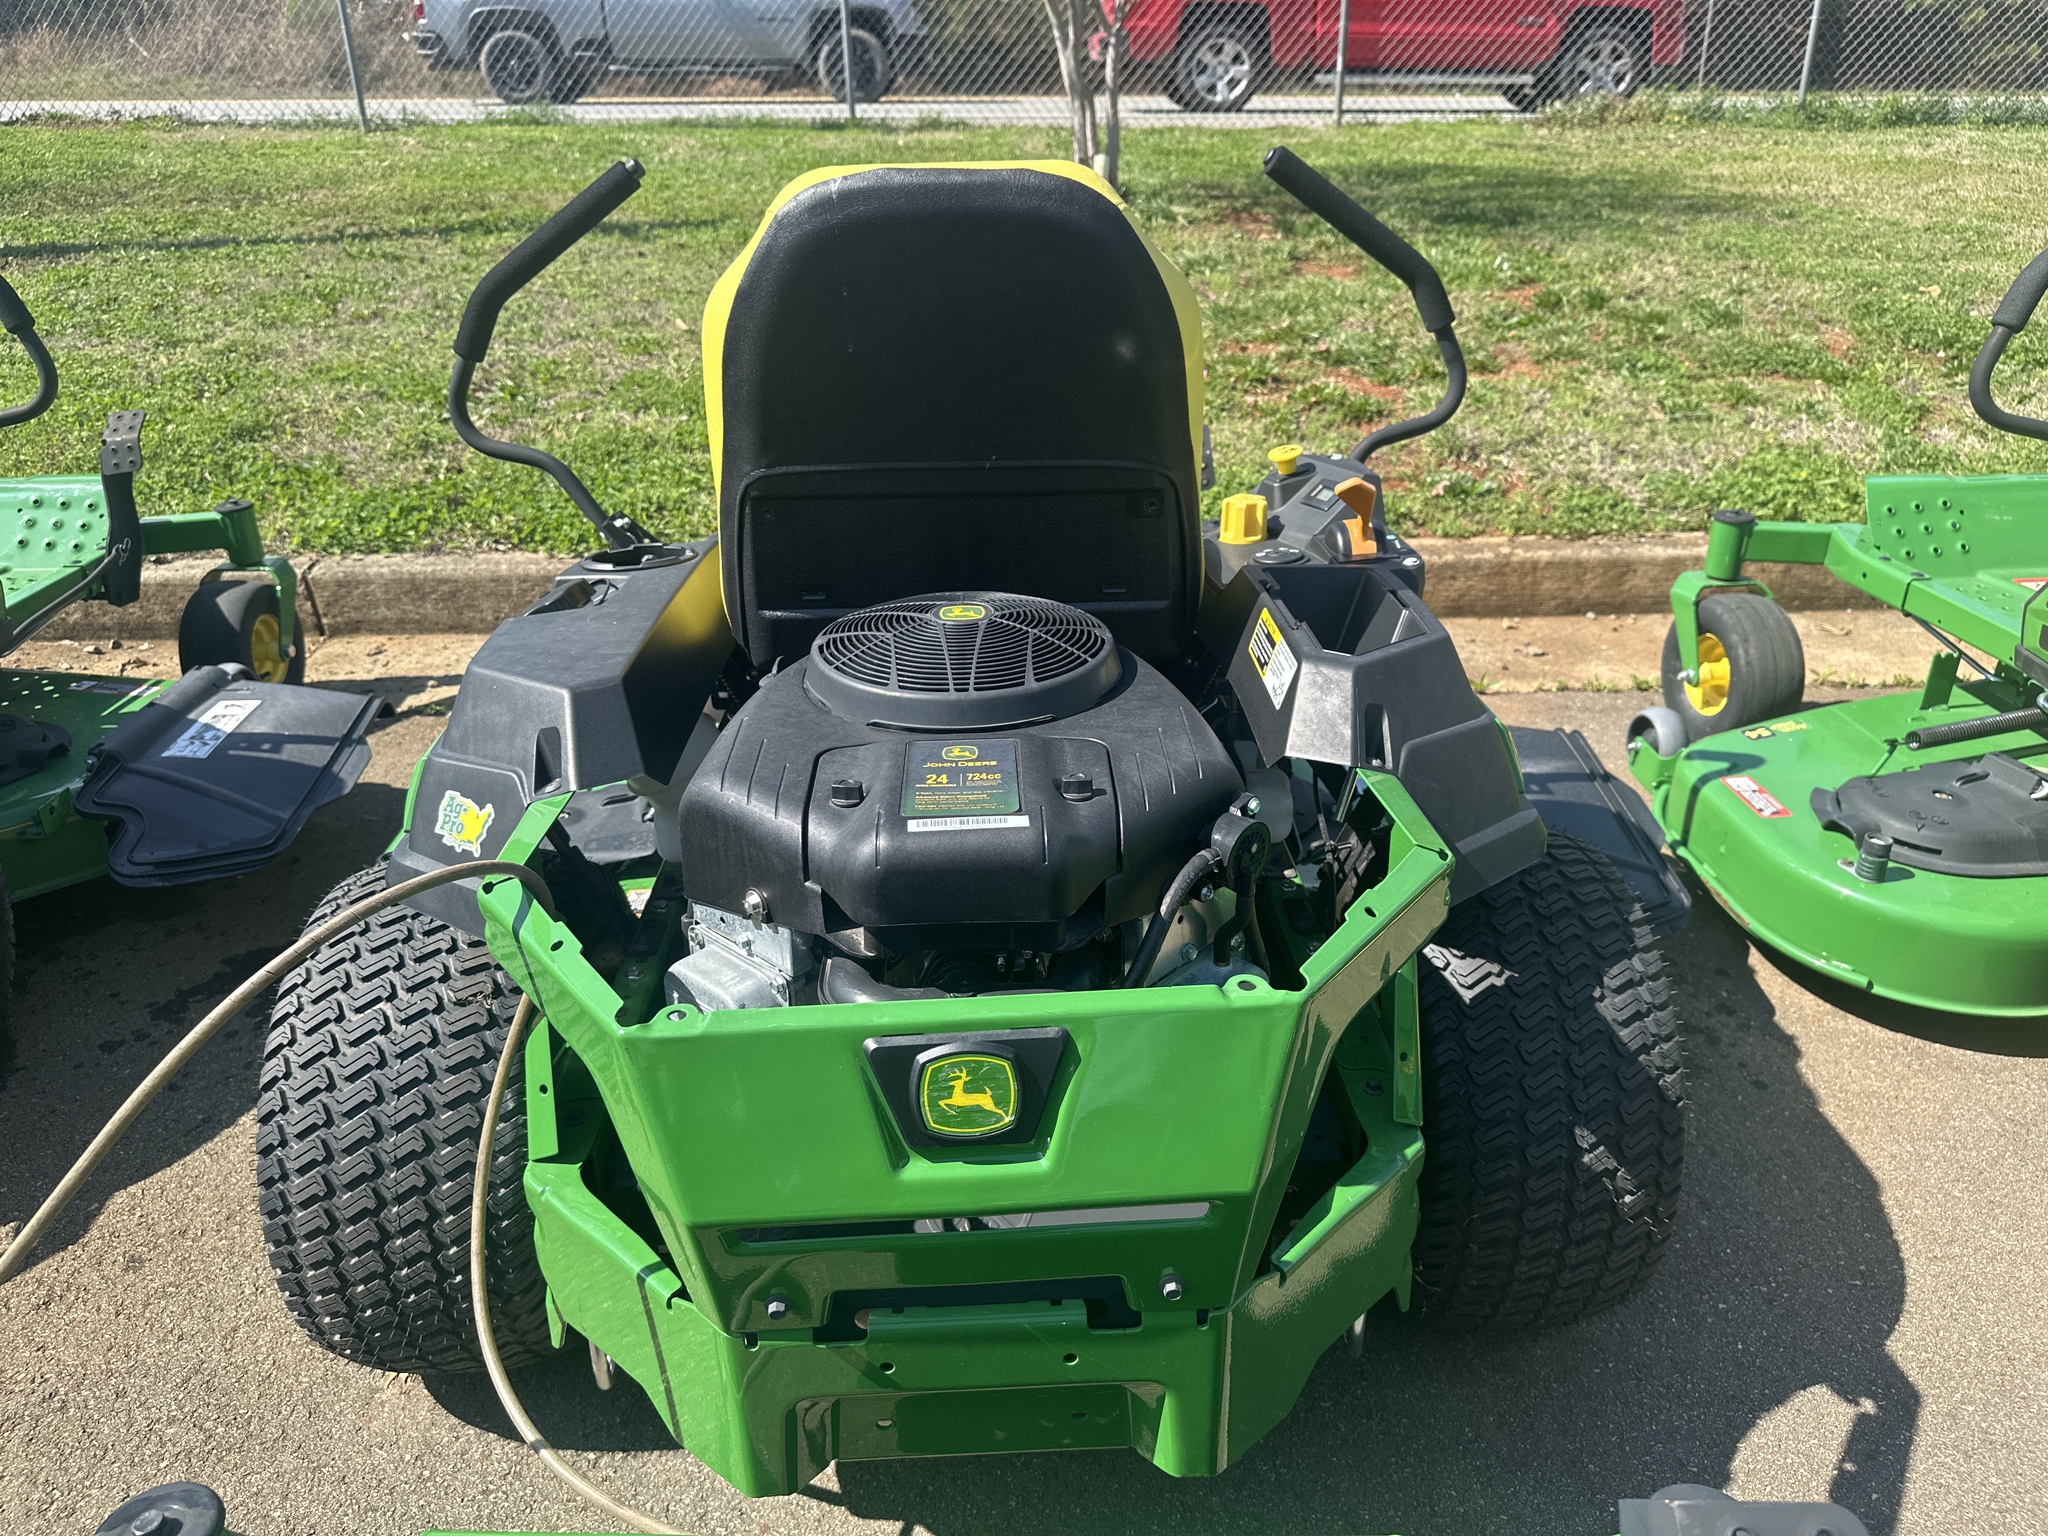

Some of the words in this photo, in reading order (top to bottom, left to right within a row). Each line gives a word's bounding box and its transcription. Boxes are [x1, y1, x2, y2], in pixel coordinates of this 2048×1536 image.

[925, 773, 949, 784] 24
[966, 772, 1002, 781] 724cc
[443, 796, 468, 819] Ag-
[440, 813, 465, 834] Pro
